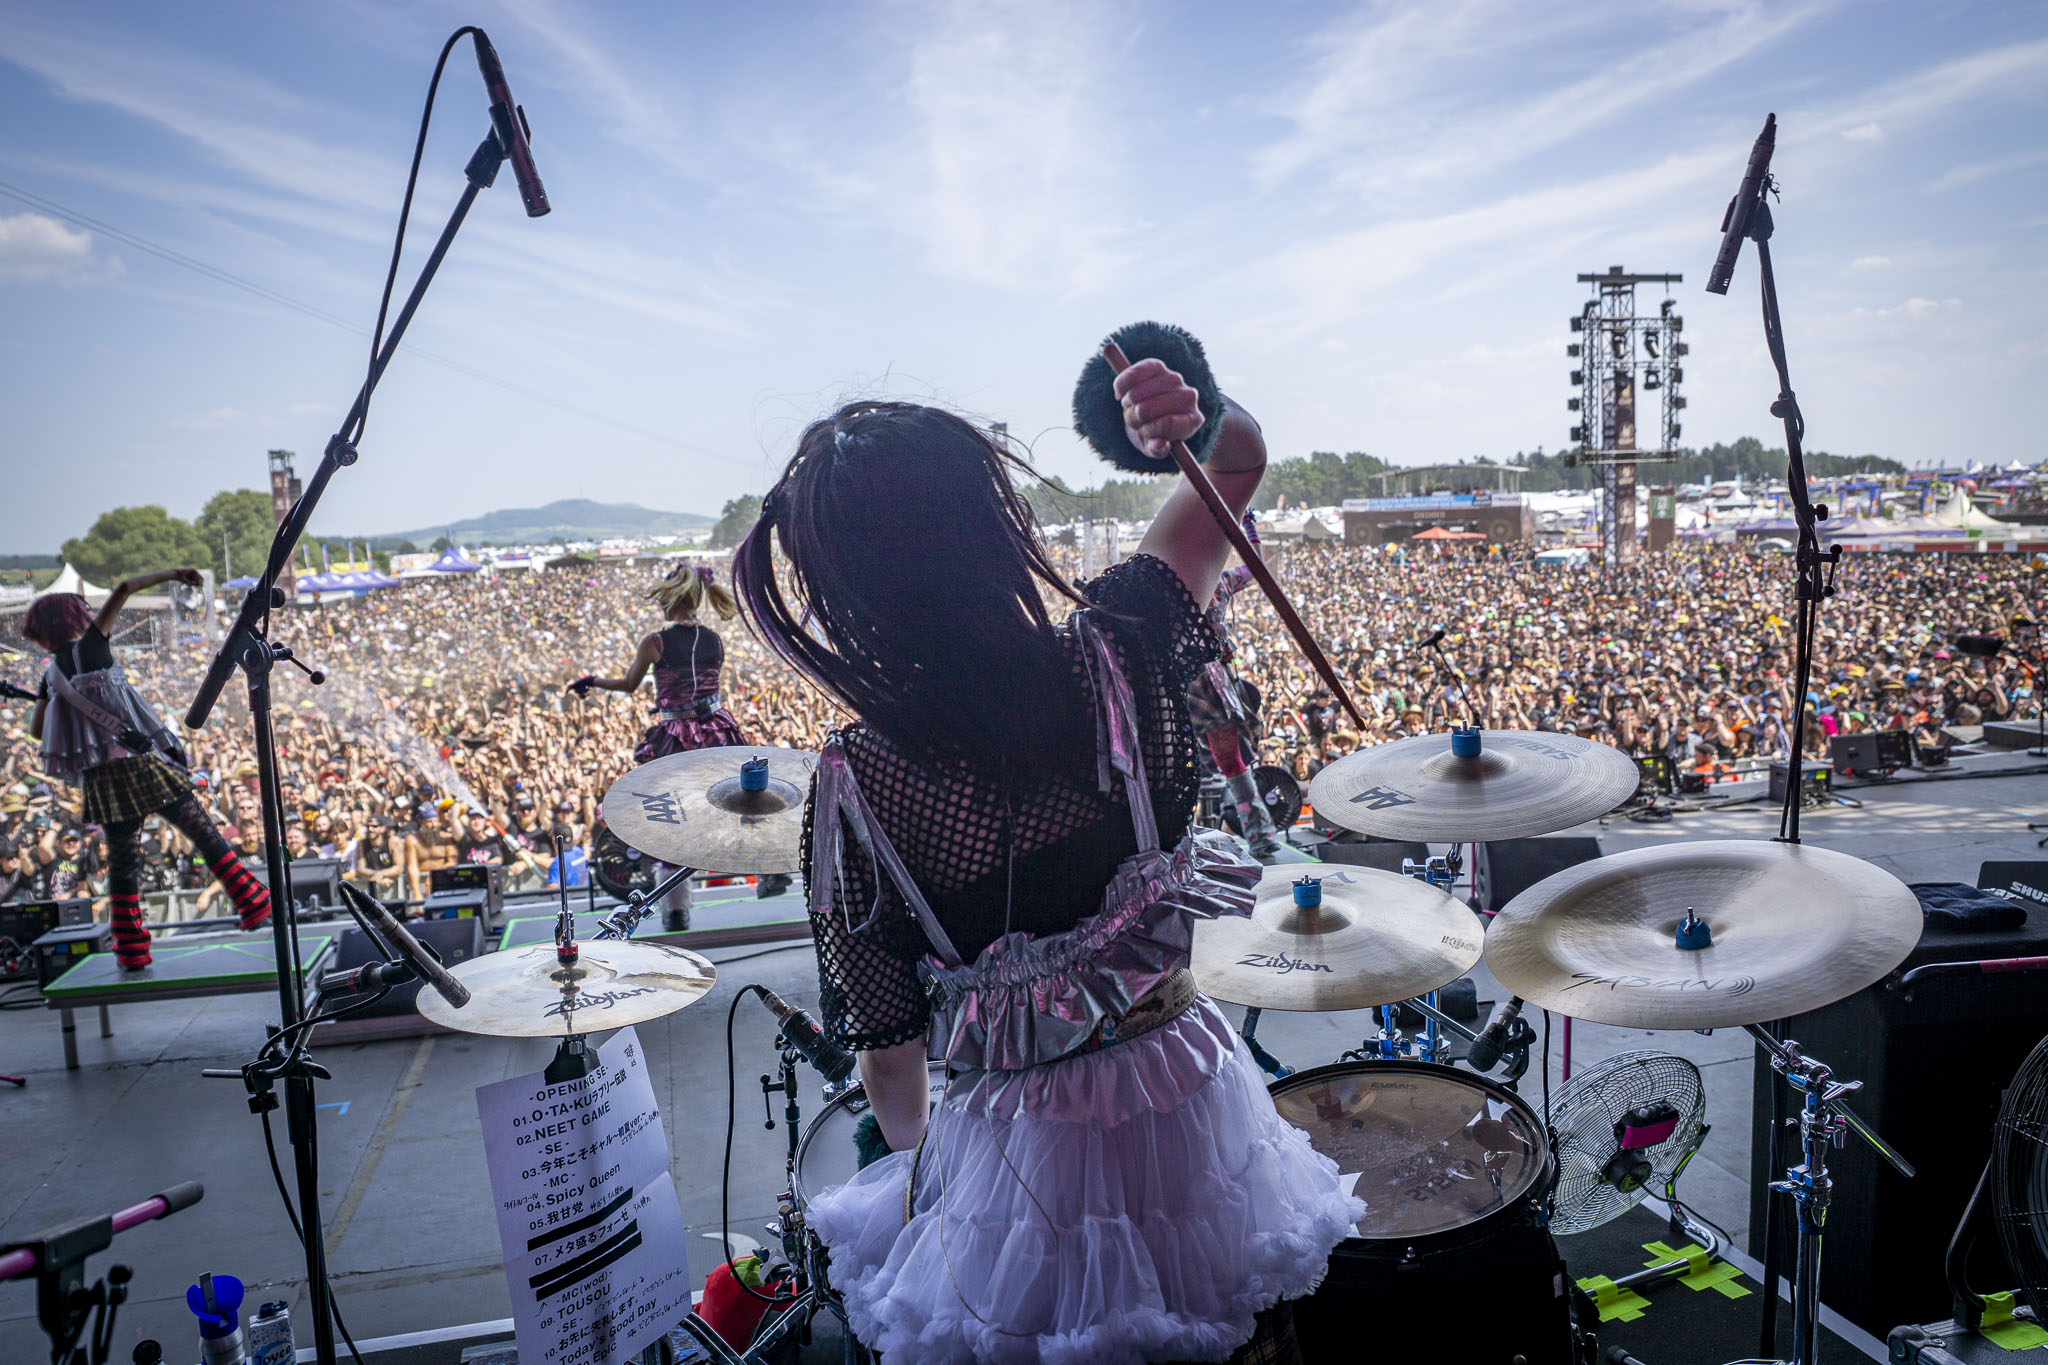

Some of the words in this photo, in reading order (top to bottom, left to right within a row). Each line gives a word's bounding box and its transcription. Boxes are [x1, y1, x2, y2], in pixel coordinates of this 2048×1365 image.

[631, 791, 681, 825] AAX
[1235, 951, 1334, 975] Zildjian
[543, 986, 657, 1018] Zildjian
[581, 1101, 611, 1127] GAME
[546, 1184, 585, 1206] Spicy
[589, 1163, 621, 1189] Queen
[557, 1283, 611, 1320] TOUSOU
[609, 1314, 635, 1337] Good
[637, 1298, 657, 1317] Day
[593, 1342, 617, 1364] Epic
